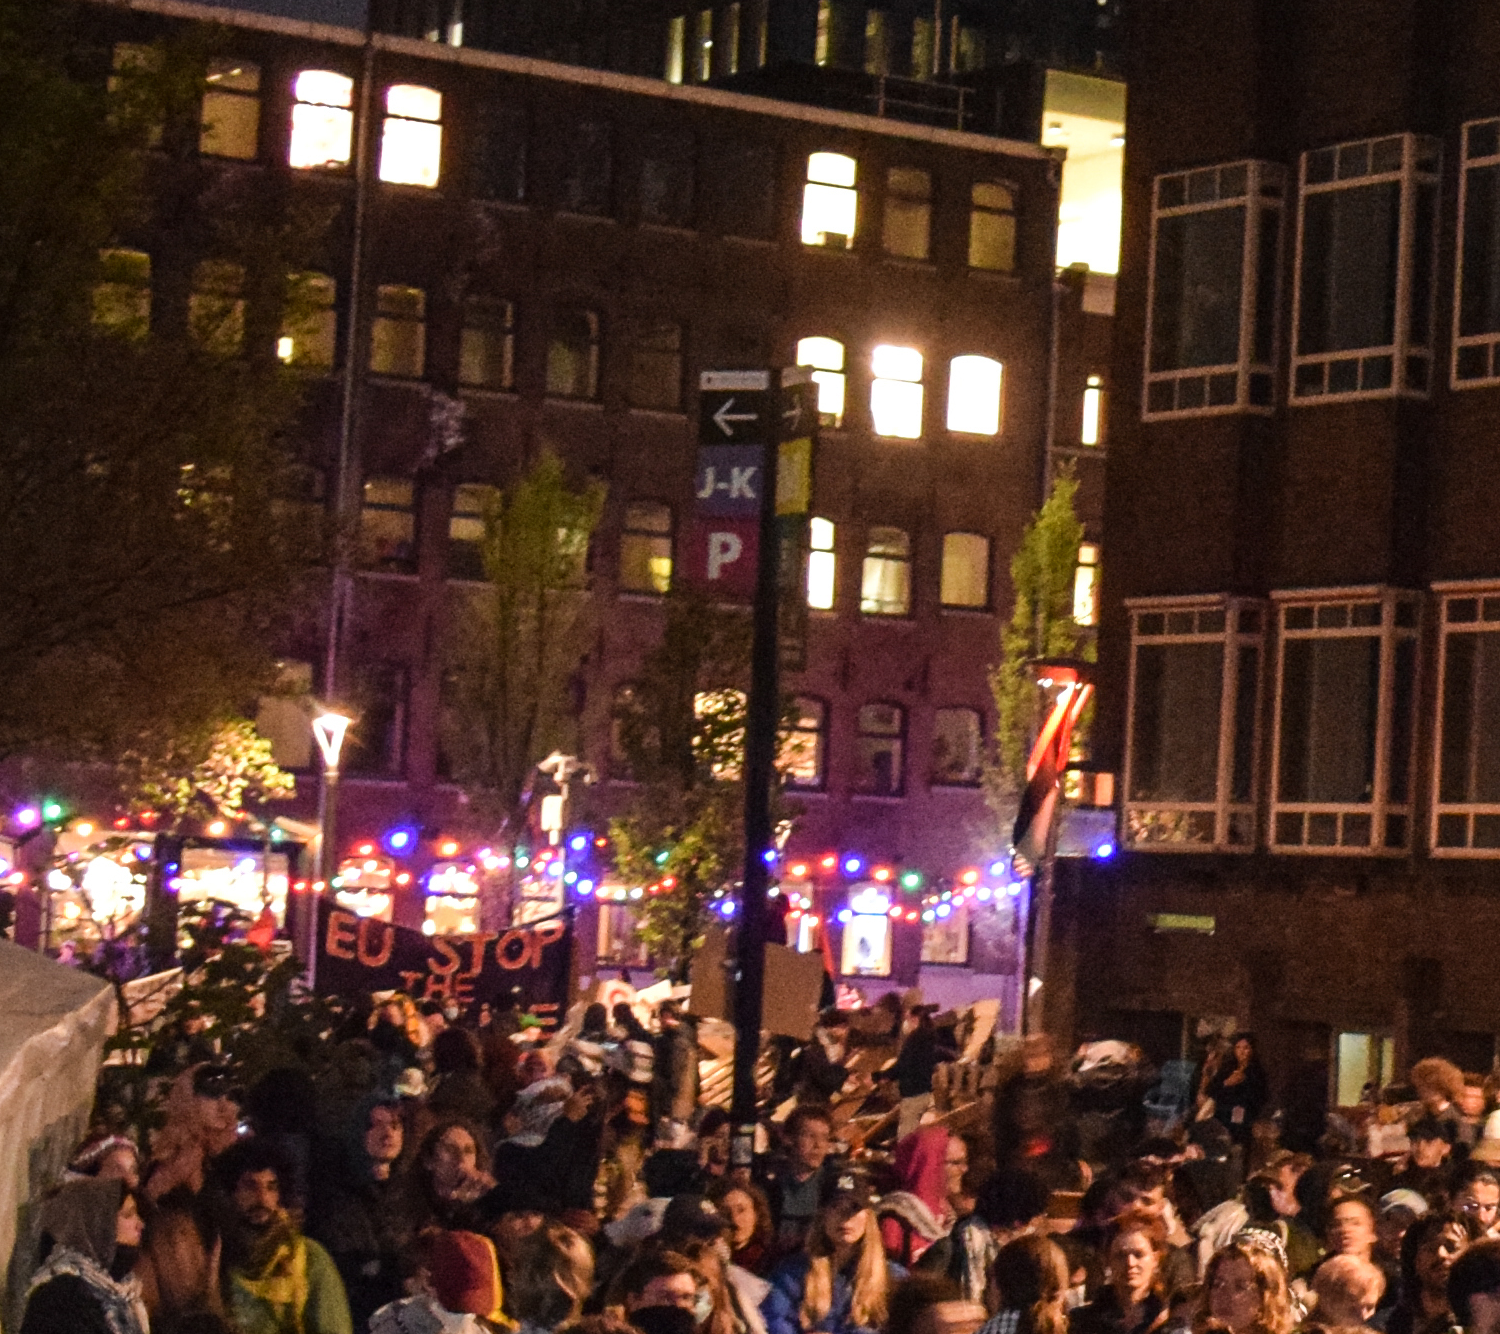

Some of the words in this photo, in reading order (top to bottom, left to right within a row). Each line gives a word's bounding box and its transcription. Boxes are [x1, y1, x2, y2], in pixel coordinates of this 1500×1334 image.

[696, 466, 758, 499] J-K
[707, 531, 743, 580] P
[325, 911, 395, 967] EU
[427, 919, 566, 978] STOP
[399, 970, 475, 1002] THE
